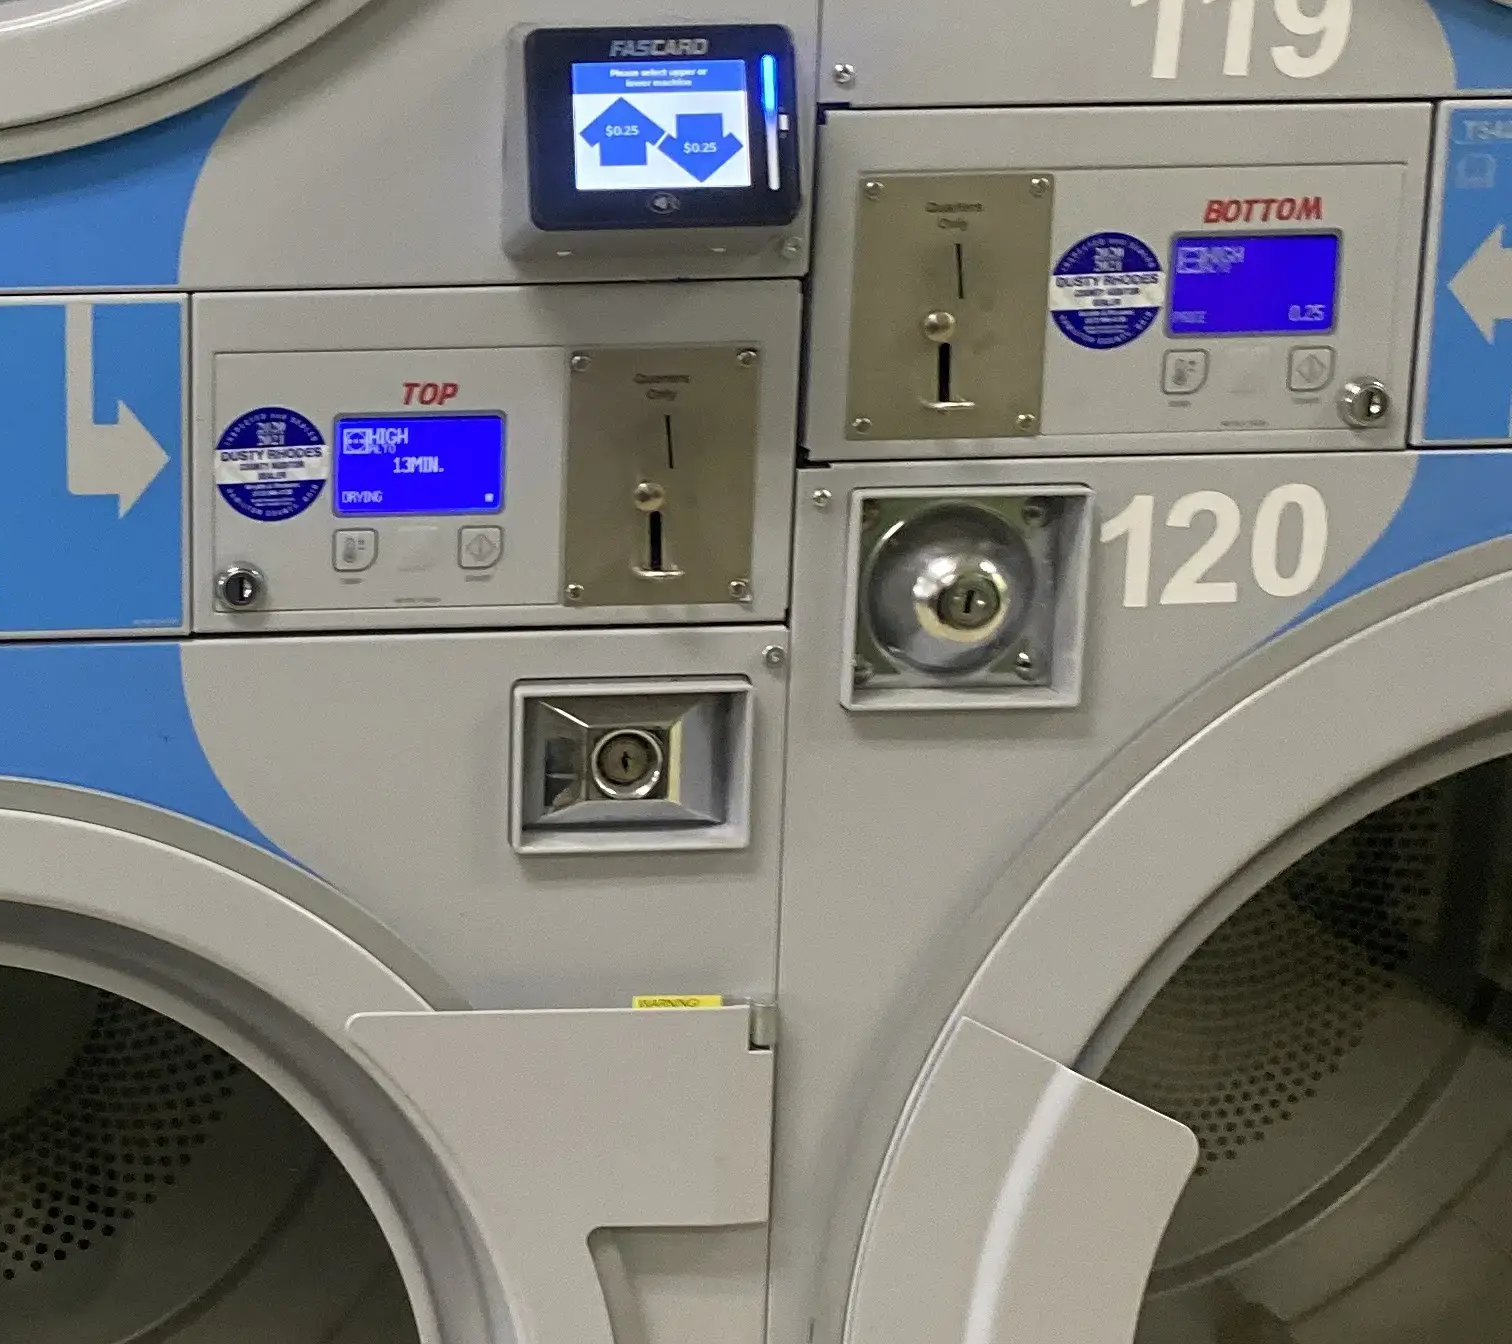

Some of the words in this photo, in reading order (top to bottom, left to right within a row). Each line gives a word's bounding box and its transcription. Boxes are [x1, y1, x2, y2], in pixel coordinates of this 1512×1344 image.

[609, 38, 710, 56] FASCARD
[605, 125, 640, 137] $0.25
[683, 142, 718, 153] $0.25
[1203, 197, 1323, 224] BOTTOM
[1288, 304, 1326, 321] 0.25
[402, 382, 460, 405] TOP
[367, 427, 409, 444] HIGH
[220, 449, 265, 462] DUSTY
[268, 446, 323, 459] RHODES
[341, 490, 383, 503] DRYING
[1100, 483, 1329, 608] 120
